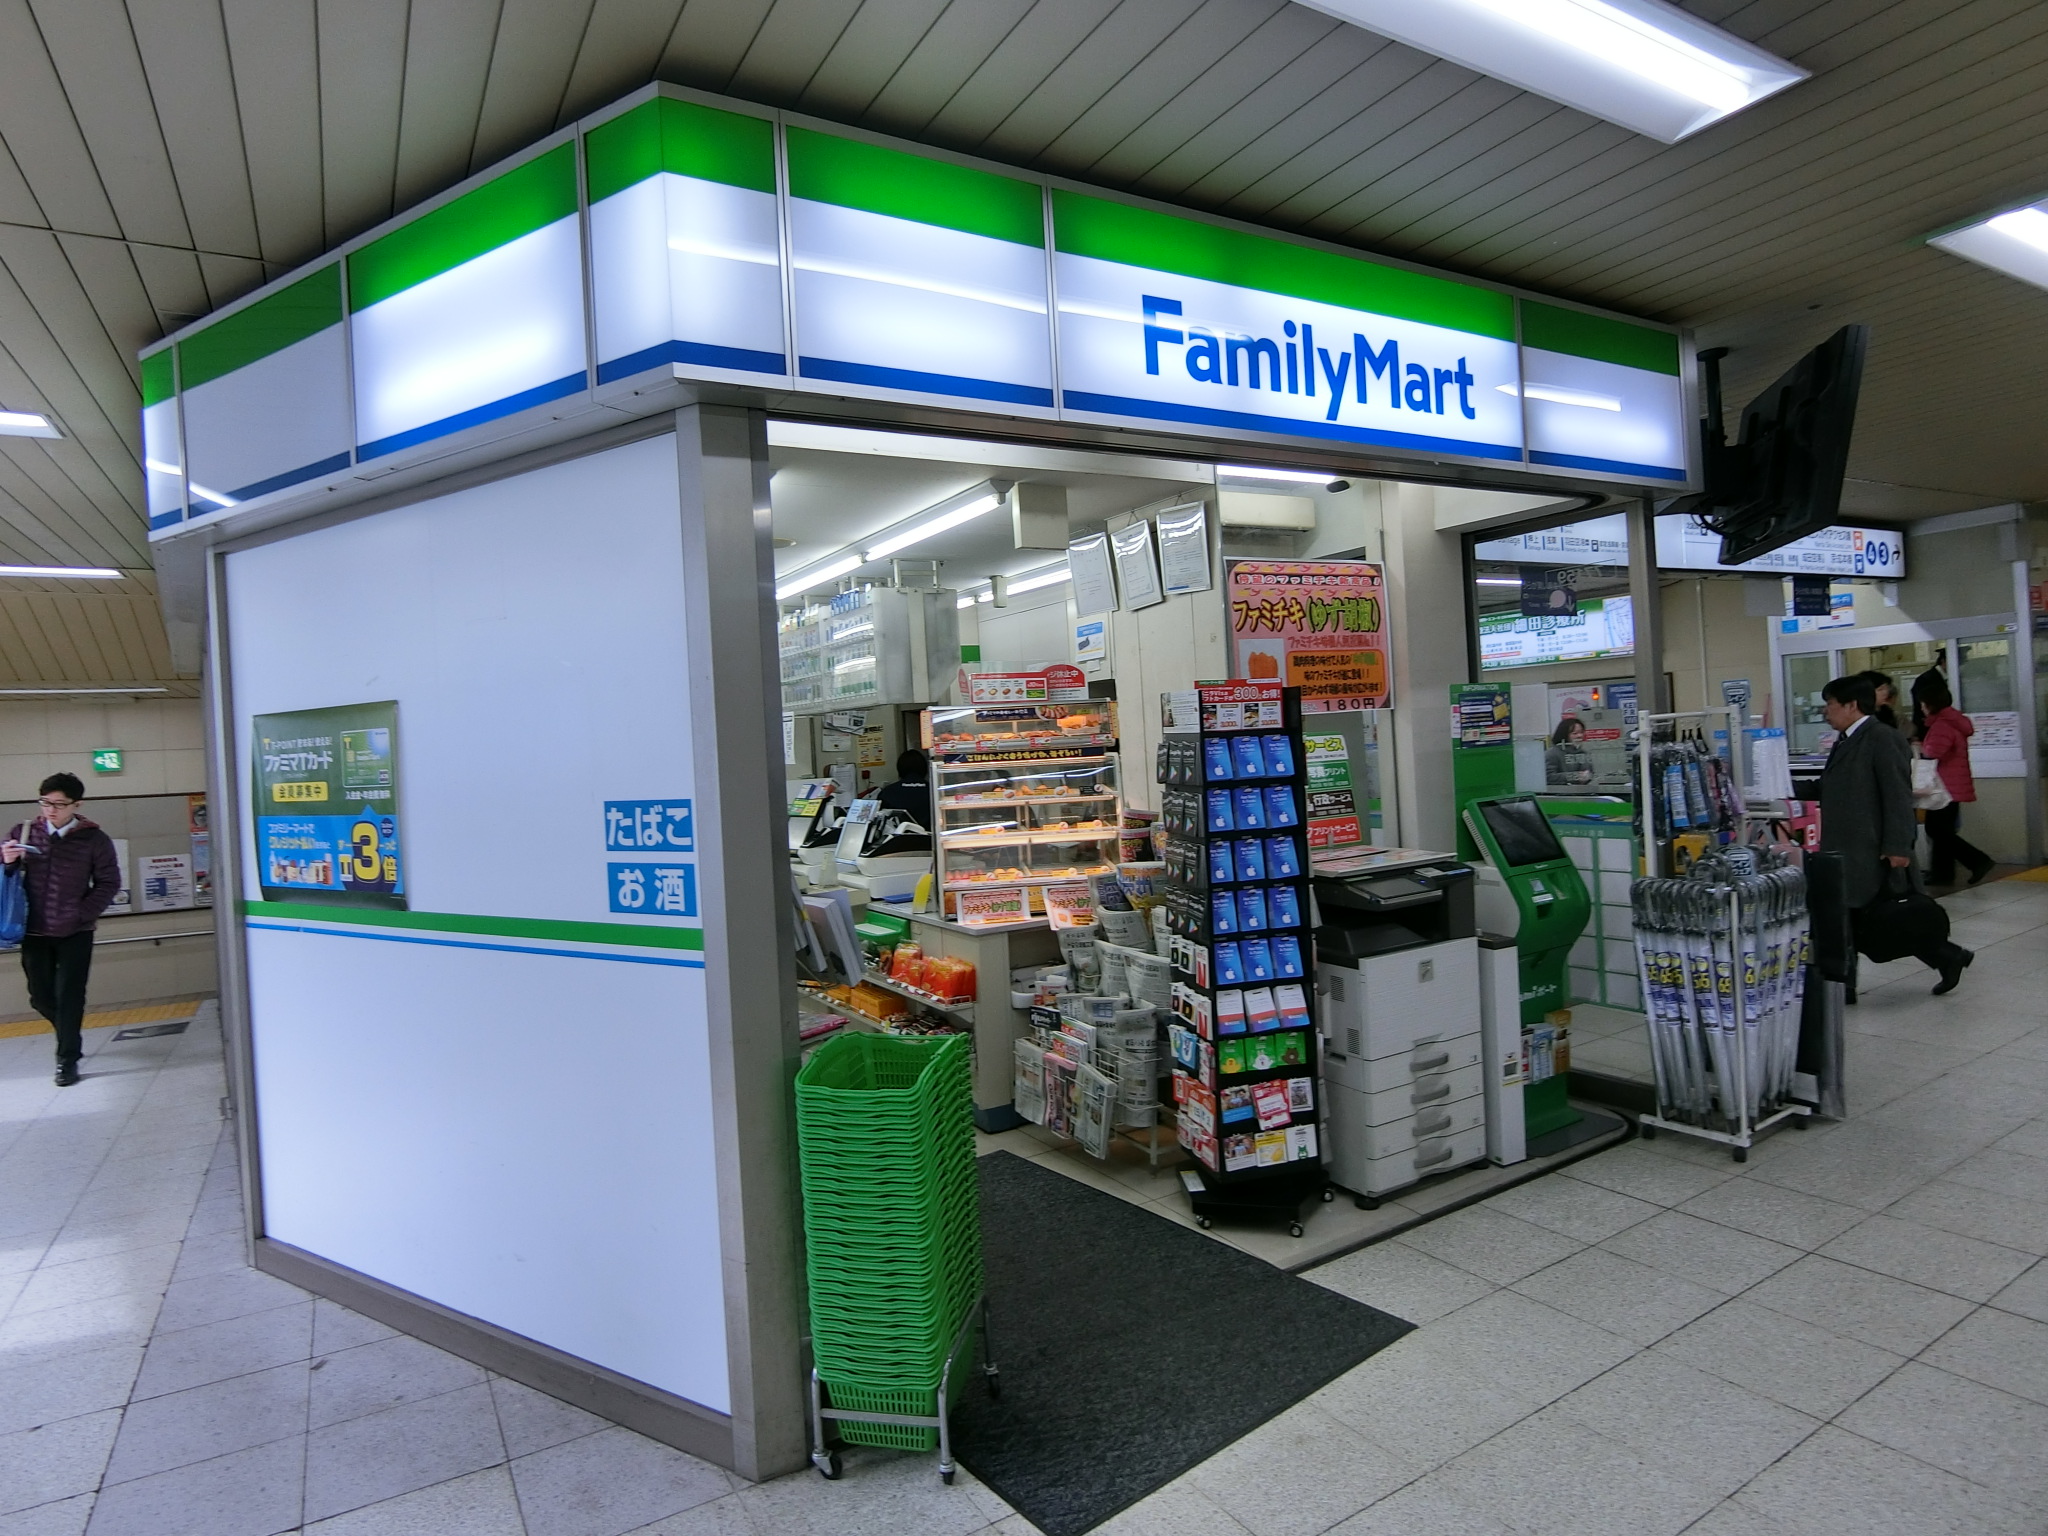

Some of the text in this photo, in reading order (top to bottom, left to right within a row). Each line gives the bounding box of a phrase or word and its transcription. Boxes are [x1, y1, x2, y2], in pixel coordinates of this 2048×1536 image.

[1142, 294, 1476, 421] FamilyMart
[1322, 697, 1376, 712] 180円
[263, 750, 334, 772] ファミマTカード
[606, 804, 693, 847] たばこ
[617, 867, 686, 912] お酒
